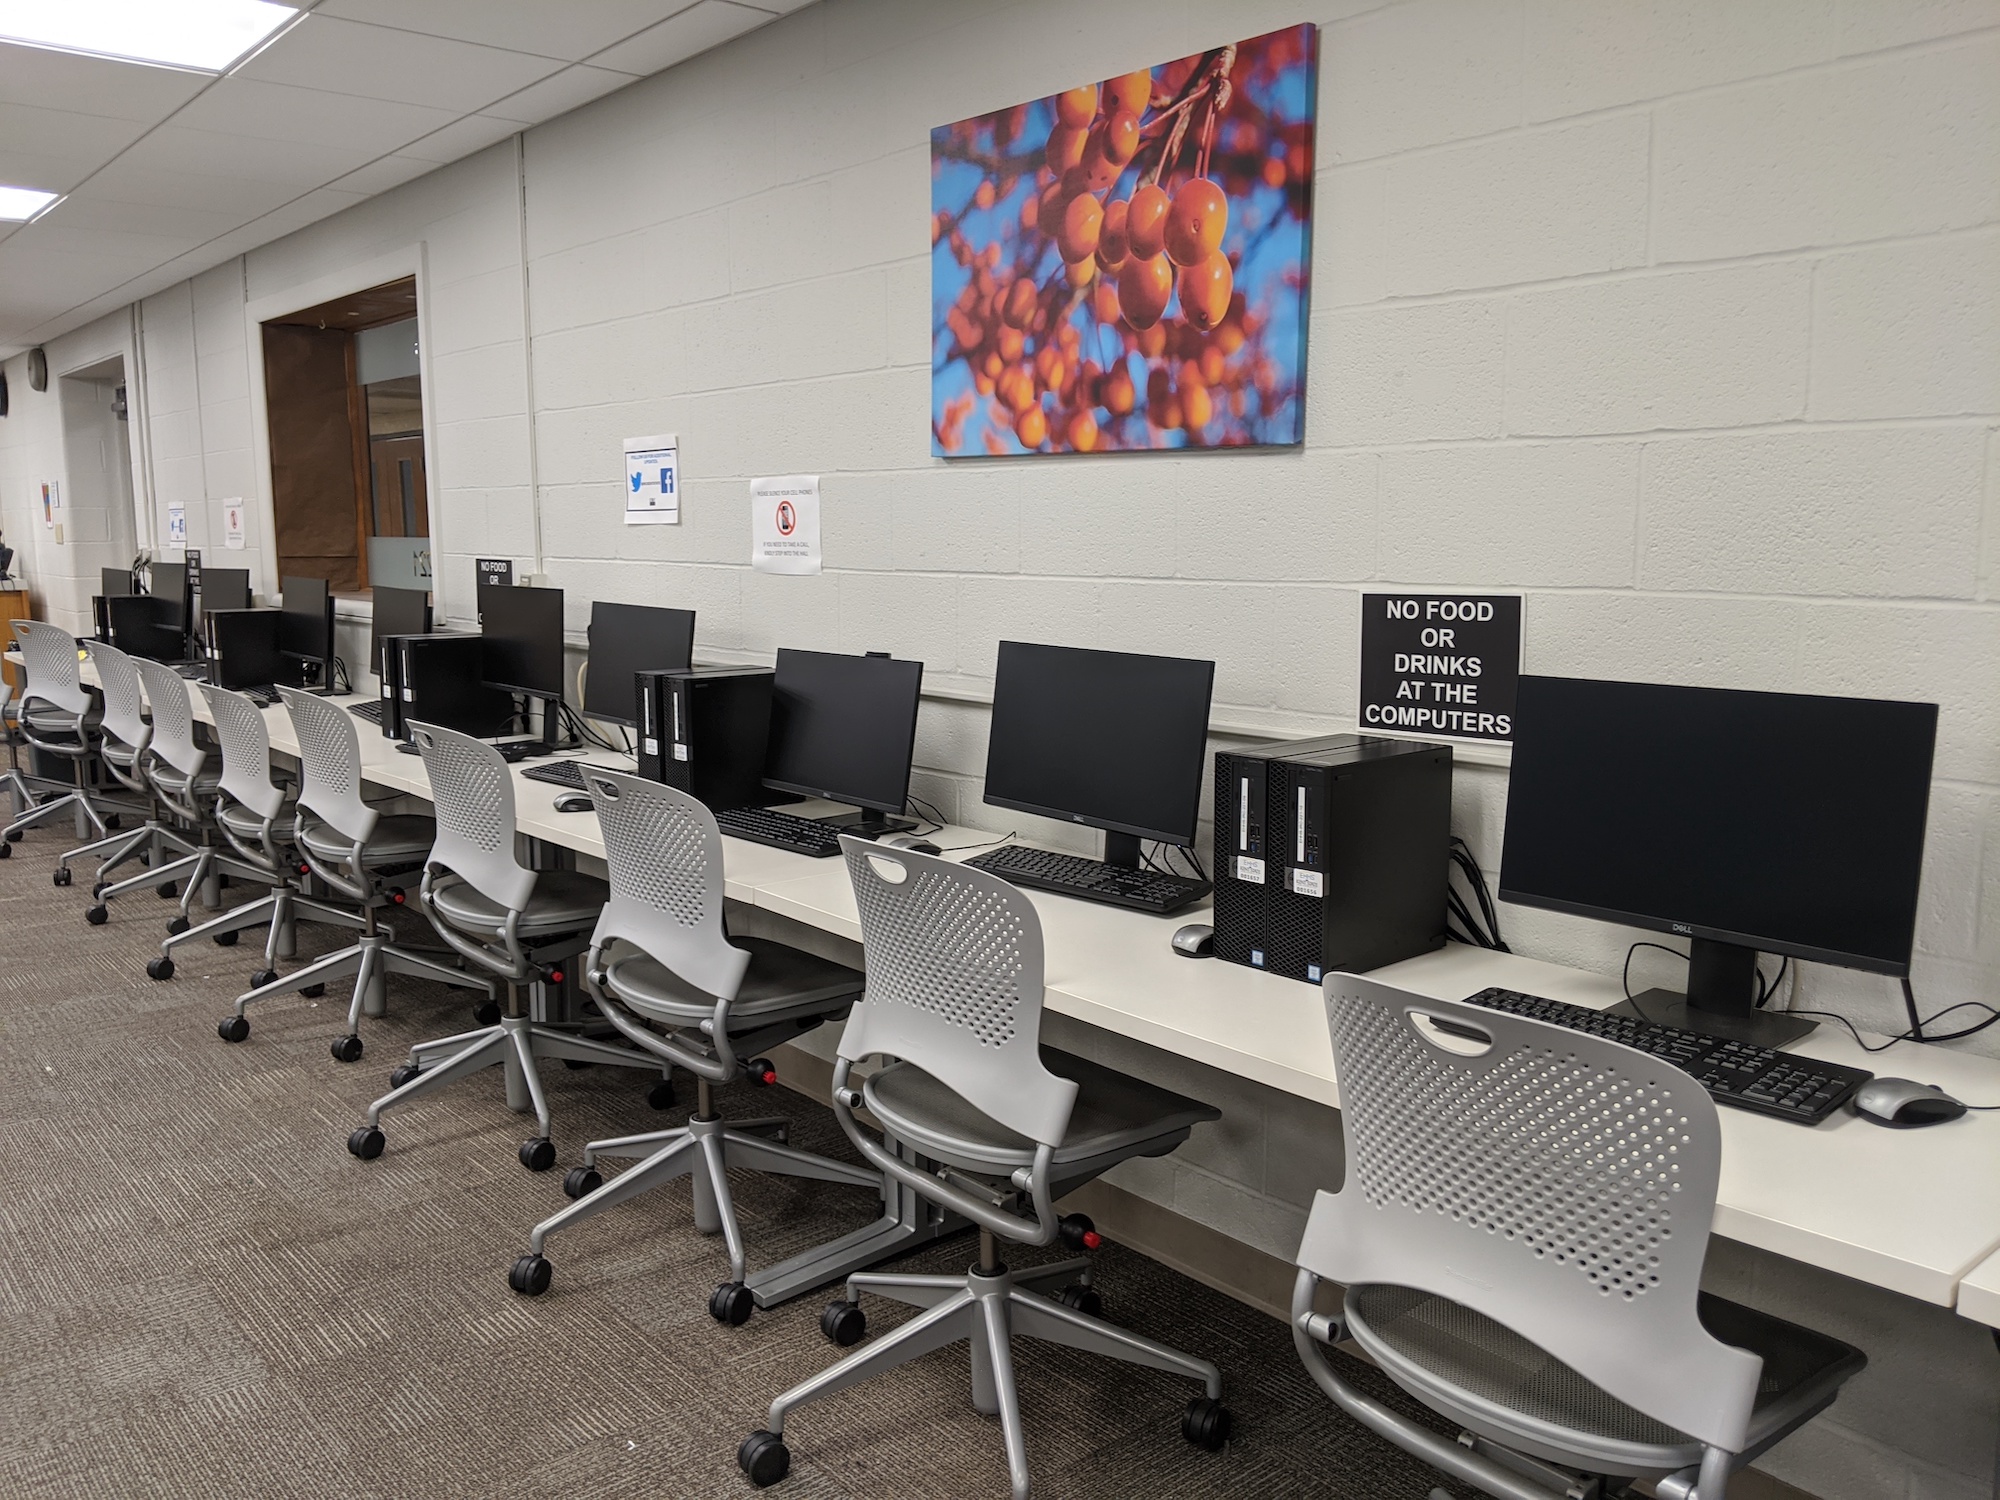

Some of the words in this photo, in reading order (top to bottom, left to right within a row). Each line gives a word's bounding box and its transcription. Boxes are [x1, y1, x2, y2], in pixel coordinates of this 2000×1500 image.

[481, 562, 489, 571] NO
[490, 562, 507, 572] FOOD
[489, 575, 499, 585] OR
[1387, 600, 1419, 619] NO
[1426, 601, 1494, 622] FOOD
[1420, 627, 1456, 648] OR
[1394, 653, 1482, 677] DRINKS
[1395, 680, 1425, 700] AT
[1431, 682, 1478, 704] THE
[1365, 704, 1512, 735] COMPUTERS
[1672, 923, 1693, 934] DELL
